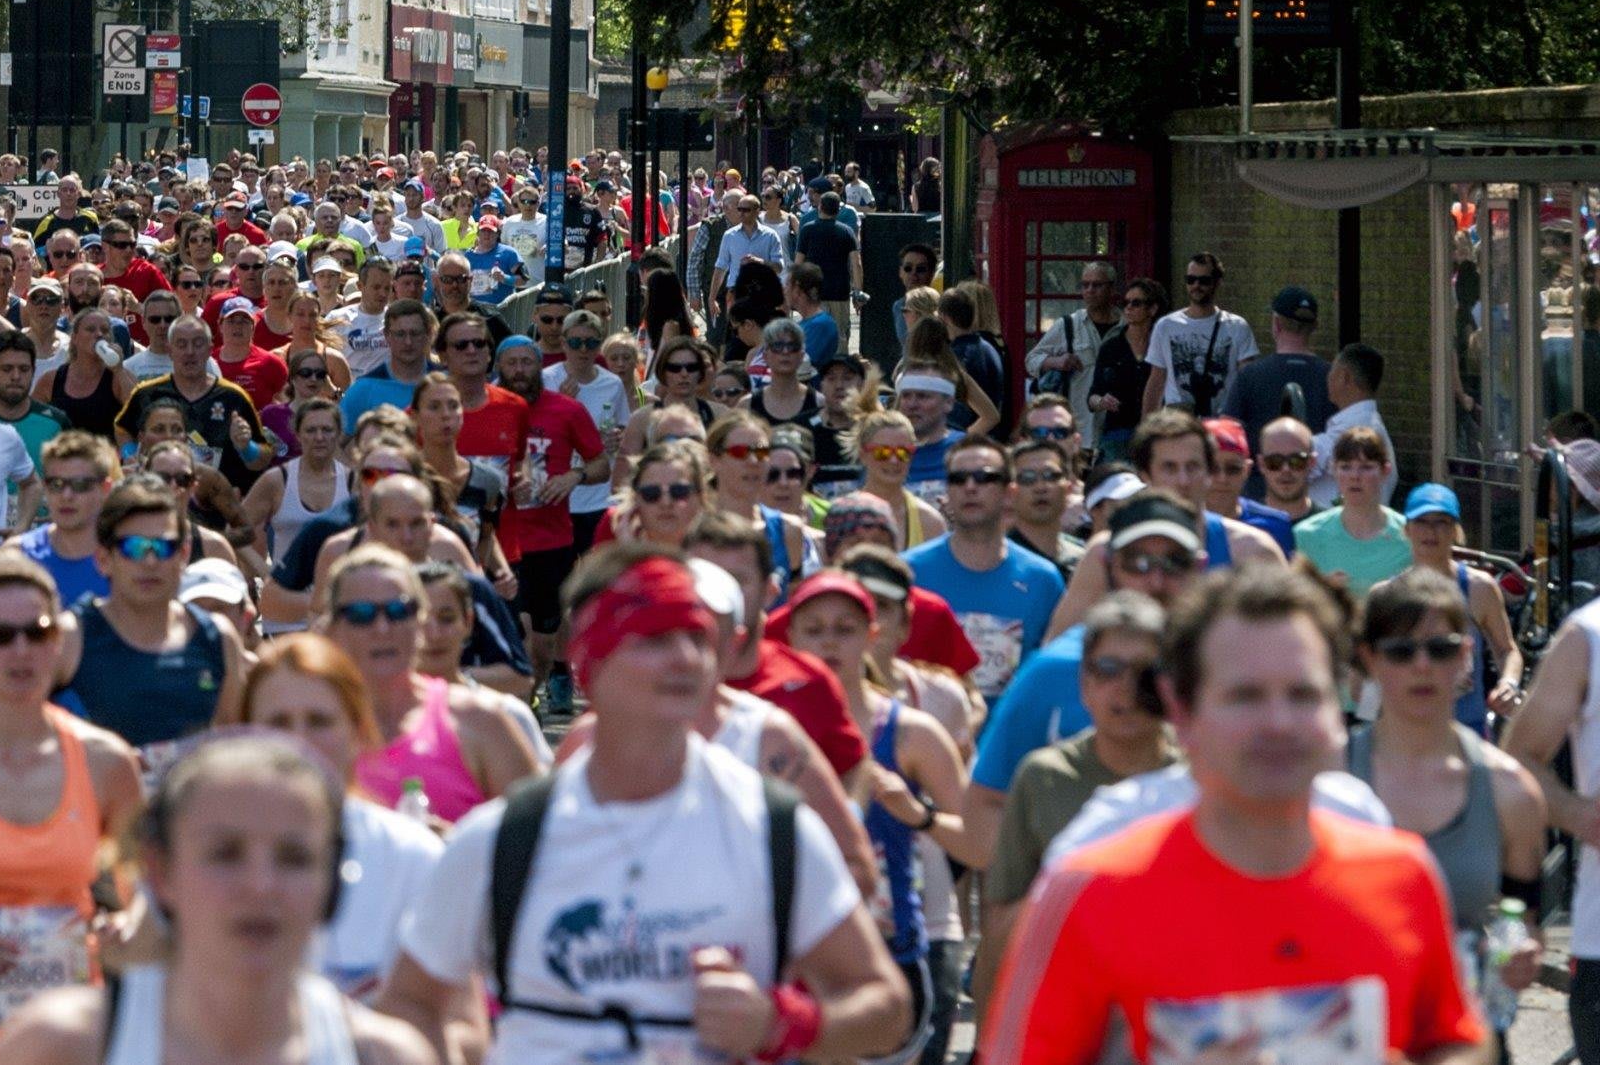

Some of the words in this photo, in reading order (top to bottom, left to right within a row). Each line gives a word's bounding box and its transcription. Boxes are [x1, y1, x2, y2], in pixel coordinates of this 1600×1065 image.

[113, 71, 135, 79] Zone
[108, 81, 141, 91] ENDS
[1023, 169, 1133, 184] TELEPHONE
[33, 190, 59, 201] CCT
[33, 204, 43, 214] in
